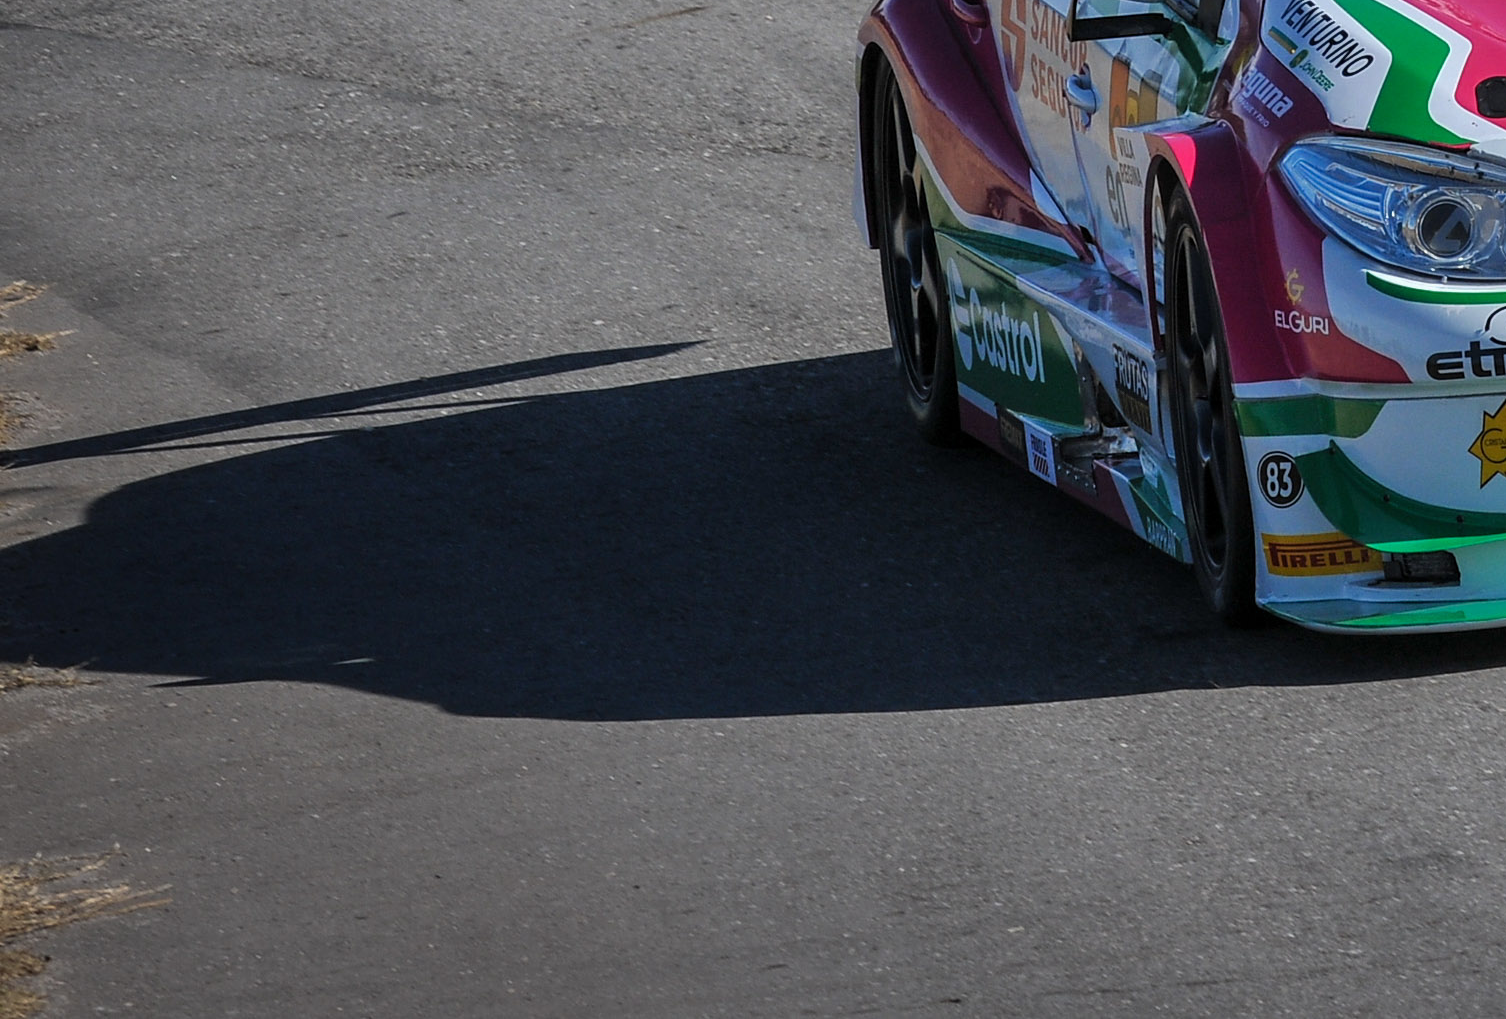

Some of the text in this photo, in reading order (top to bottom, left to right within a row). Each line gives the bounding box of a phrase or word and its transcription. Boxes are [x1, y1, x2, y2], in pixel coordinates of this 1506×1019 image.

[969, 287, 1046, 383] Castrol
[1266, 461, 1293, 499] 83
[1267, 542, 1370, 568] PIRELLI
